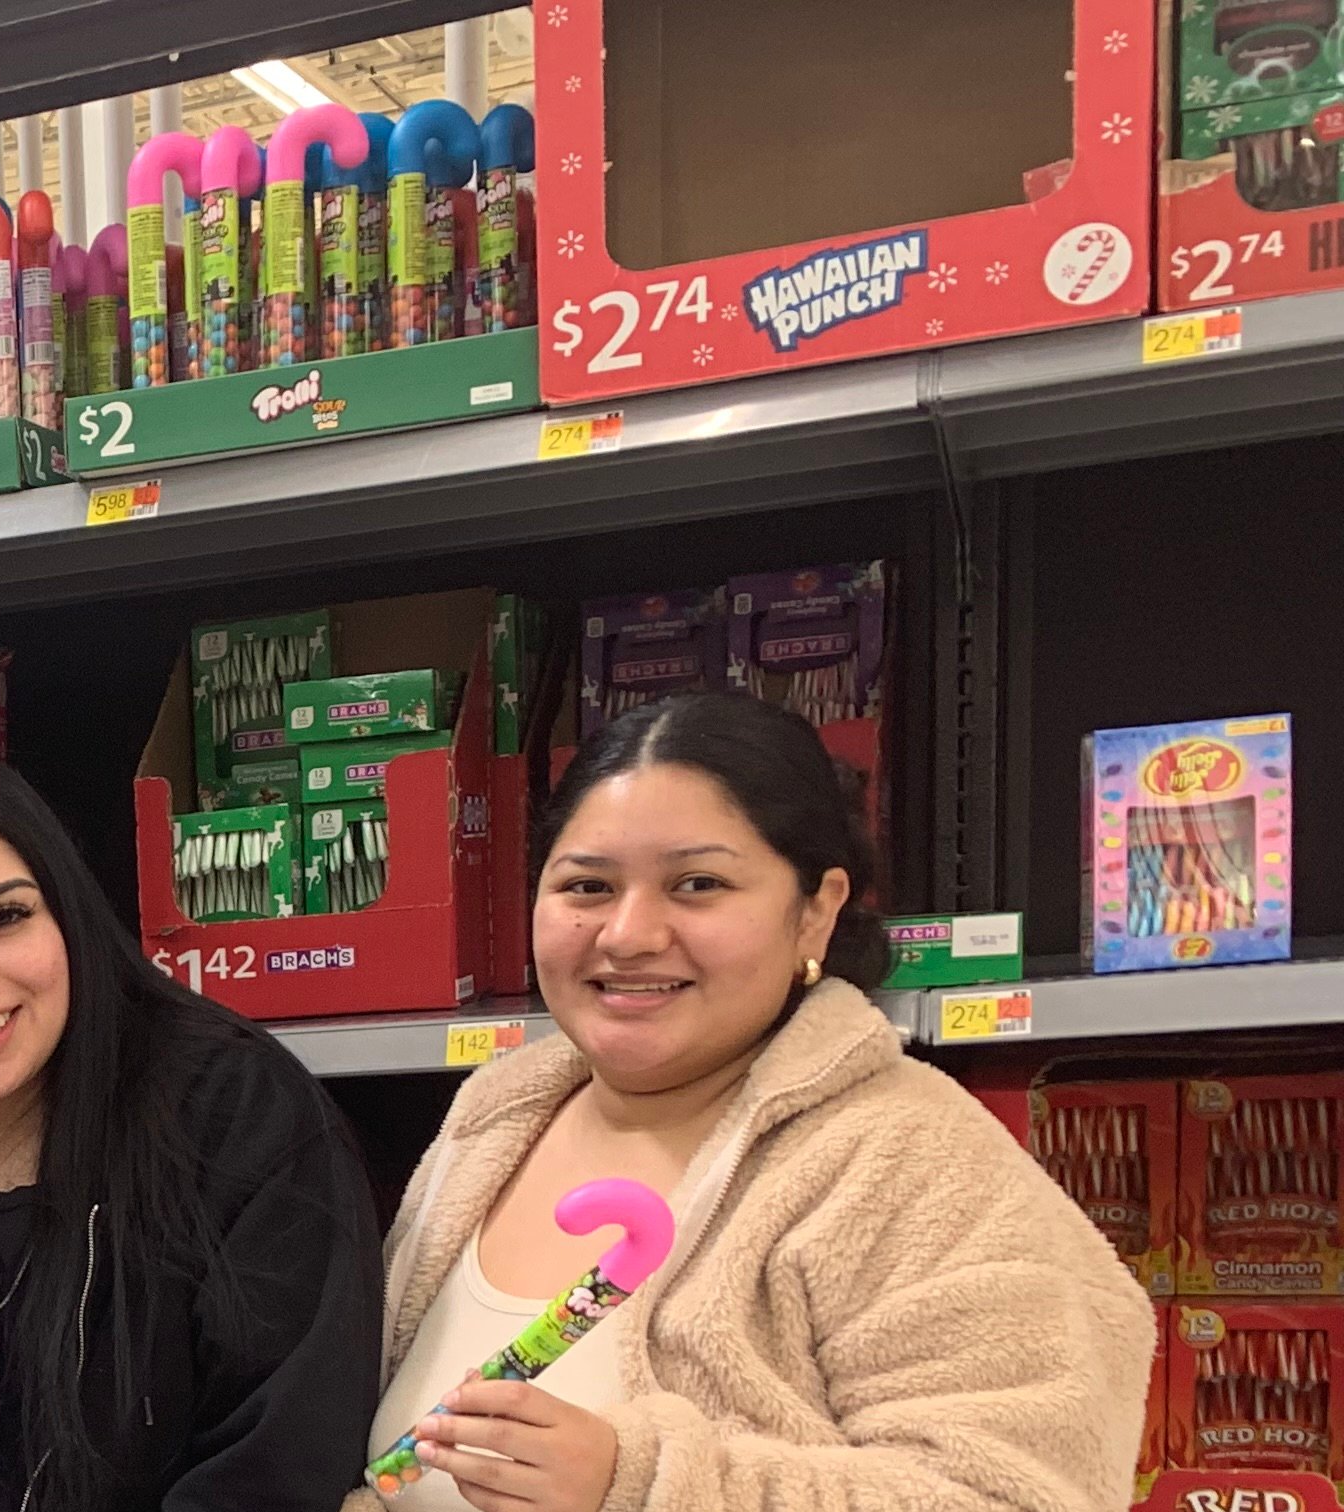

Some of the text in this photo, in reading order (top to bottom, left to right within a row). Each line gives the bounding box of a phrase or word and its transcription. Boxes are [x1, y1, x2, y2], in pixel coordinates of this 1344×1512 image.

[750, 236, 923, 325] HAWAIIAN
[1167, 230, 1285, 301] $274
[552, 275, 713, 375] $274
[771, 280, 897, 350] PUNCH
[252, 369, 323, 423] Trolli
[78, 402, 136, 457] $2
[319, 812, 334, 825] 12
[1211, 1203, 1339, 1225] RED HOTS
[1214, 1260, 1322, 1276] Cinnamon
[1215, 1277, 1322, 1291] Candy Canes
[1199, 1427, 1255, 1447] RED
